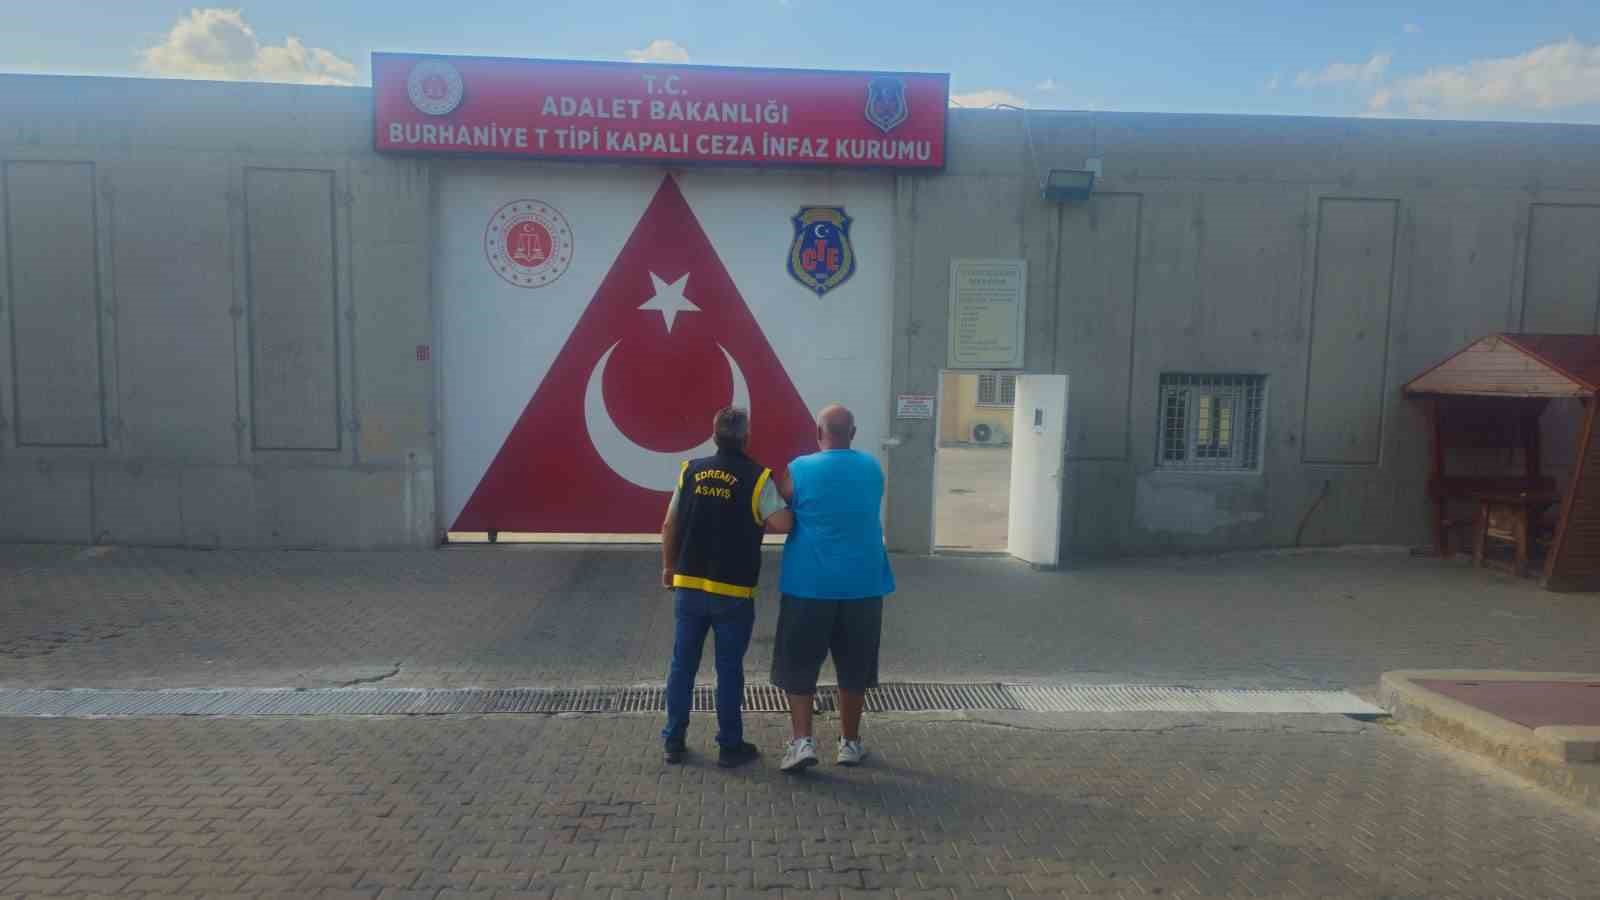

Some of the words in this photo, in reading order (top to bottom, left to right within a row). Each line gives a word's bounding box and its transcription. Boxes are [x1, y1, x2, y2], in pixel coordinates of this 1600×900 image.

[641, 74, 688, 96] T.C.
[541, 96, 642, 120] ADALET
[651, 99, 789, 125] BAKANLIĞI
[388, 122, 529, 148] BURHANİYE
[536, 129, 548, 149] T
[554, 125, 600, 150] TİPİ
[606, 129, 689, 153] KAPALI
[696, 134, 755, 156] CEZA
[763, 132, 829, 158] İNFAZ
[836, 139, 931, 161] KURUMU
